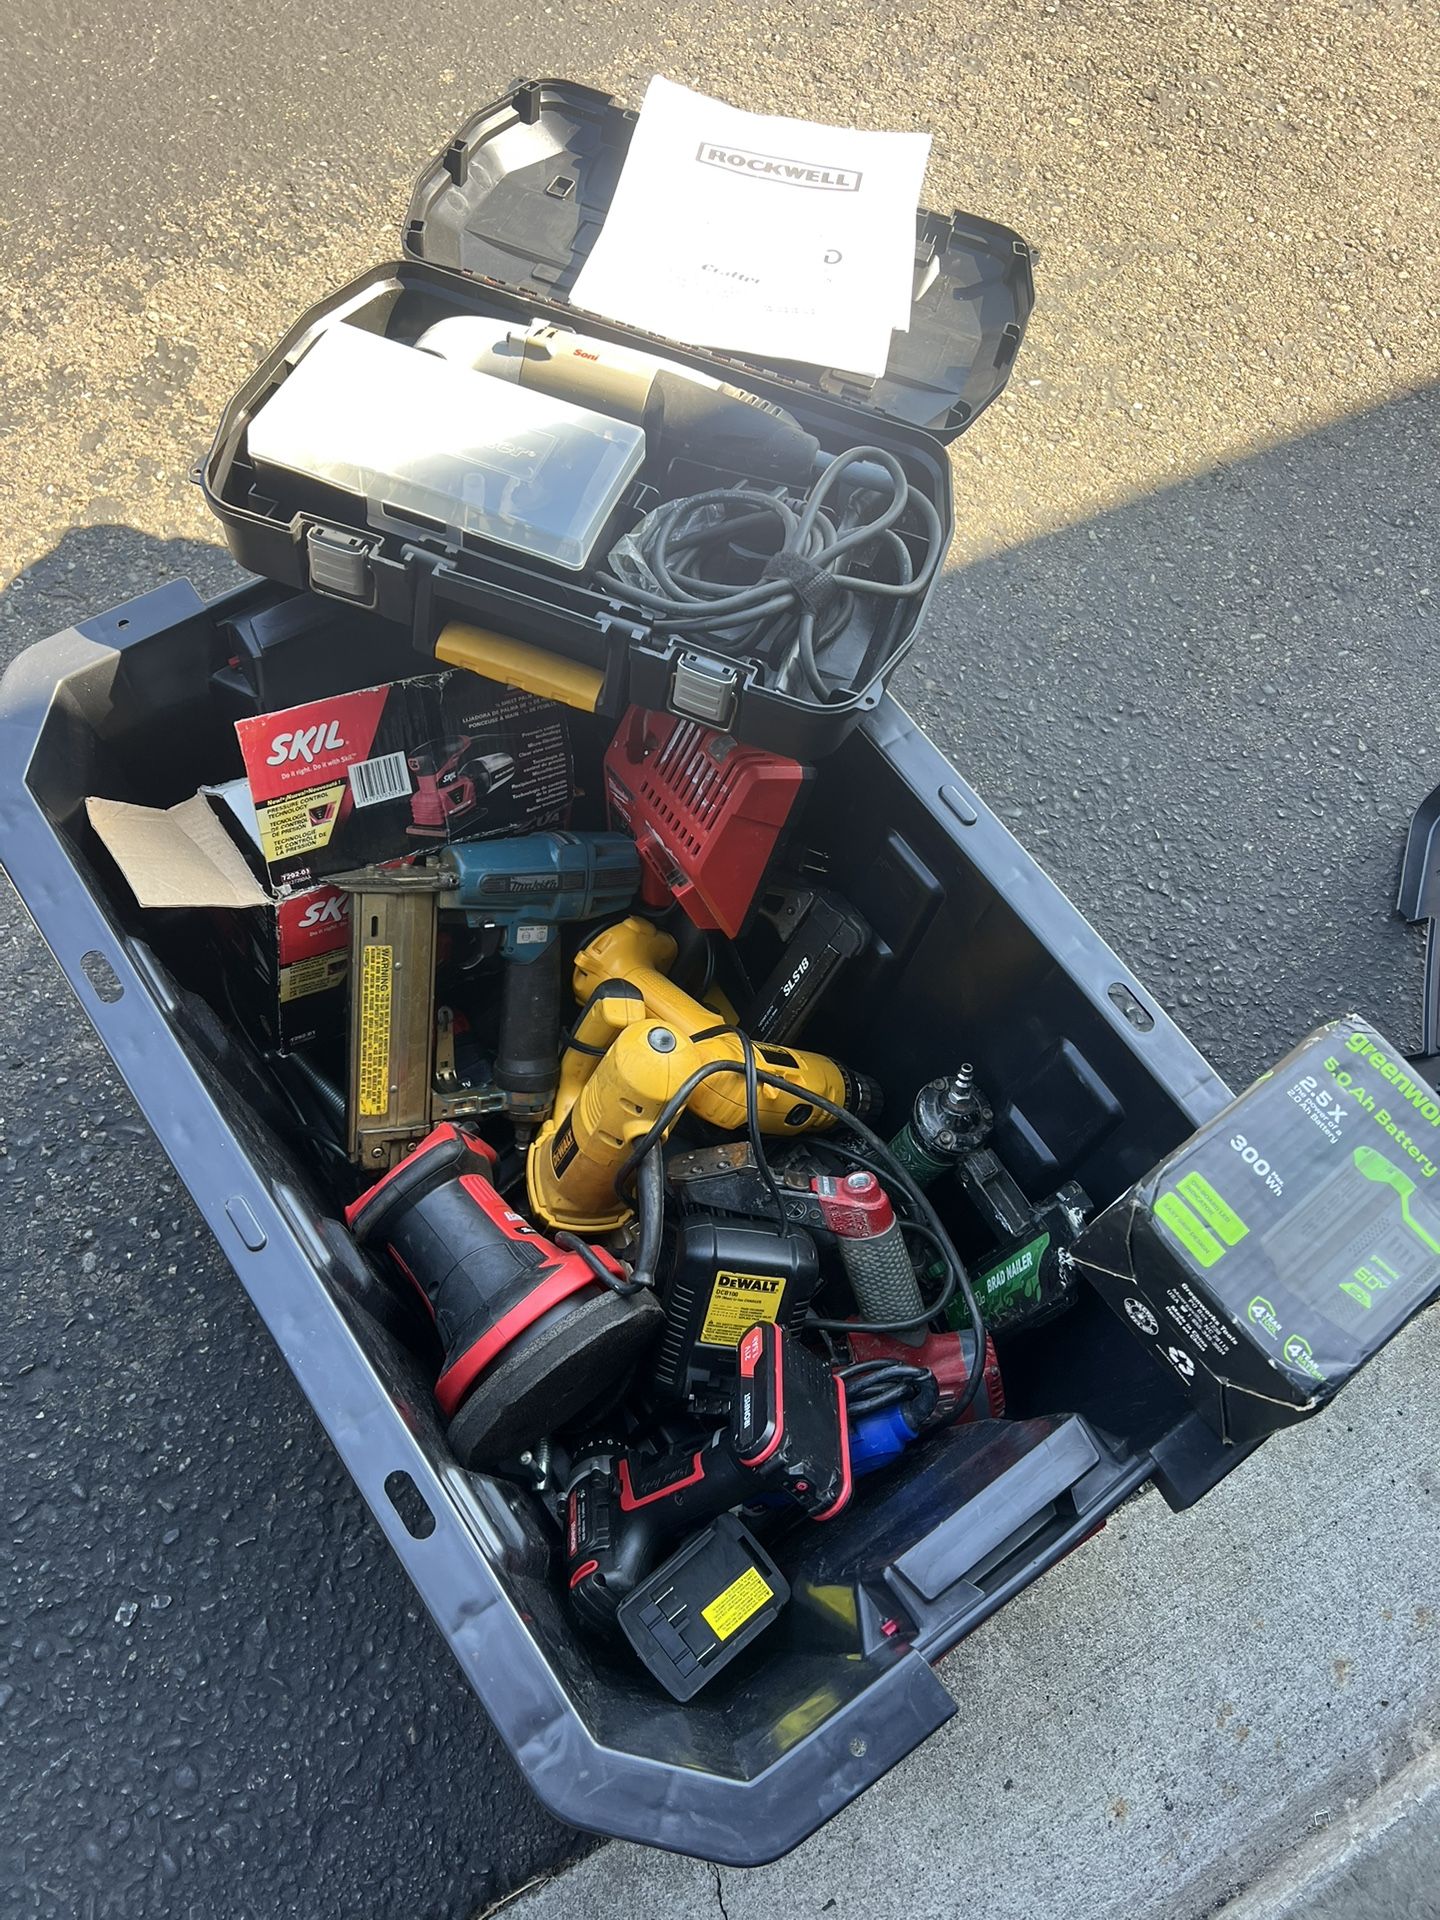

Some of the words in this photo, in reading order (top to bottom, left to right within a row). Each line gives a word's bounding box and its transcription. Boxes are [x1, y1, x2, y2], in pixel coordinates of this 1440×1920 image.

[708, 149, 848, 189] ROCKWELL
[573, 349, 598, 360] Soni
[266, 721, 345, 766] SKIL
[295, 766, 311, 775] right.
[266, 800, 298, 814] PRESSURE
[299, 792, 328, 804] CONTROL
[268, 804, 307, 818] TECHNOLOGY
[273, 829, 316, 845] TECHNOLOGIE
[280, 818, 307, 828] CONTROL
[285, 840, 316, 852] PRESSION
[380, 948, 390, 993] WARNING
[783, 957, 808, 996] SLS18
[1286, 1089, 1301, 1102] 2.0
[1298, 1102, 1311, 1114] Ah
[1310, 1113, 1337, 1143] Battery
[1293, 1084, 1306, 1097] the
[1304, 1097, 1328, 1120] power
[1327, 1120, 1338, 1129] of
[1299, 1076, 1332, 1106] 2.5
[1327, 1103, 1347, 1123] X
[1323, 1055, 1352, 1090] 5.0
[1348, 1087, 1374, 1111] Ah
[1374, 1109, 1436, 1176] Battery
[1230, 1134, 1269, 1175] 300
[1265, 1175, 1281, 1196] Wh
[986, 1270, 1005, 1292] BRAD
[1006, 1251, 1032, 1279] NAILER
[1165, 1306, 1182, 1325] Hecho
[1182, 1326, 1189, 1334] en
[1189, 1334, 1205, 1351] China
[1170, 1305, 1186, 1322] Made
[1191, 1330, 1207, 1347] China
[1181, 1283, 1219, 1325] Greenworks
[1220, 1325, 1237, 1344] Tools
[1249, 1305, 1265, 1317] 4
[1264, 1312, 1281, 1330] YEAR
[1260, 1315, 1278, 1334] TOOL
[1285, 1344, 1302, 1356] 4
[1301, 1350, 1319, 1369] YEAR
[1297, 1354, 1326, 1380] BATTERY
